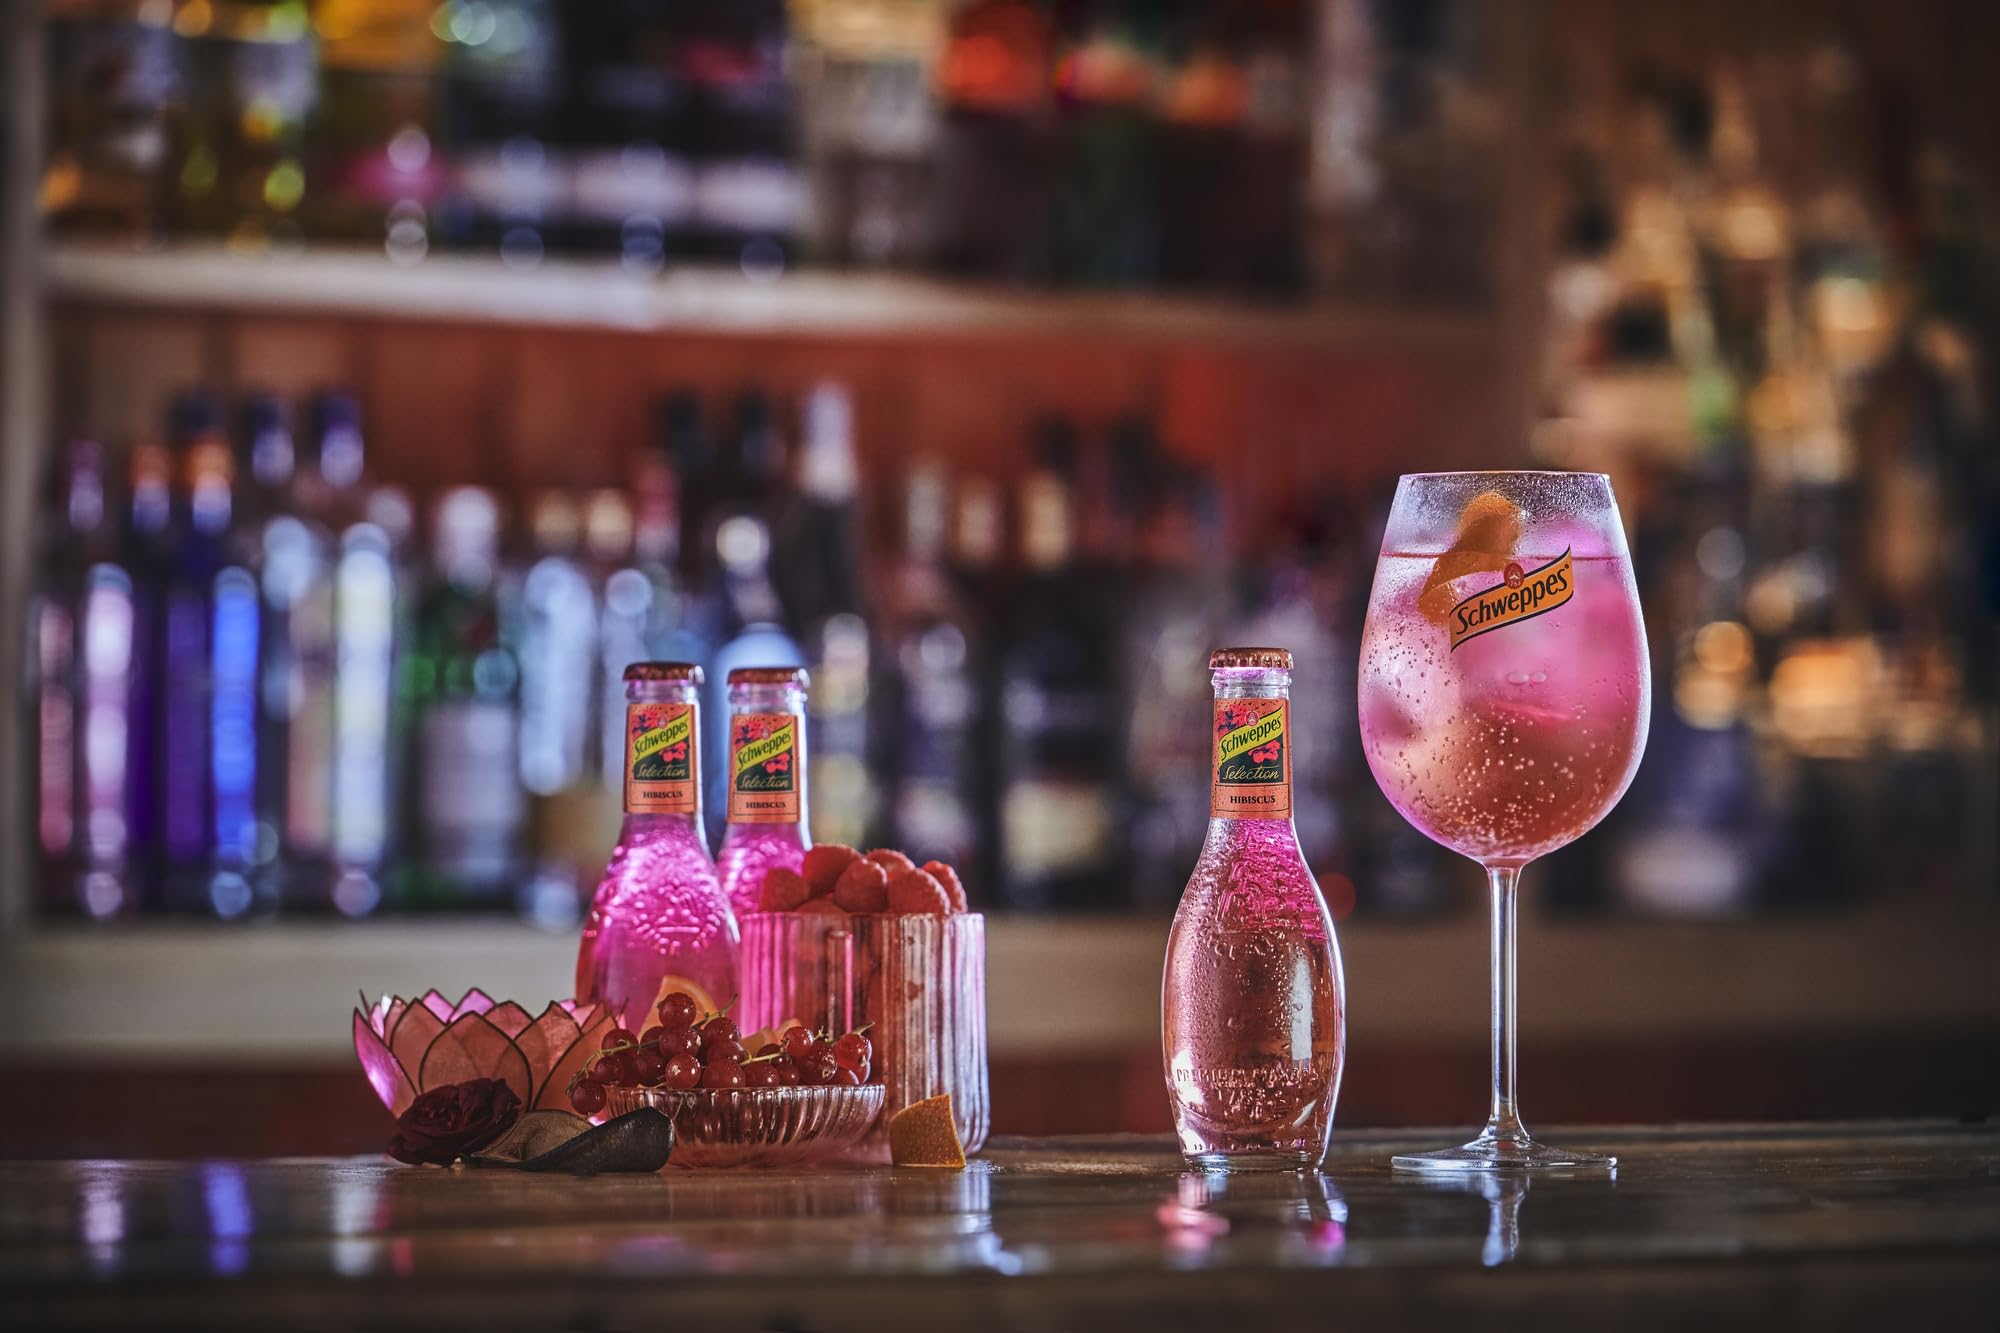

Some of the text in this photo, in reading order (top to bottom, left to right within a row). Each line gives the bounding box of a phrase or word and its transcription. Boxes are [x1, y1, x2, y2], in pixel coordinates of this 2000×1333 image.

[1456, 568, 1568, 635] Schweppes
[634, 720, 688, 760] Schweppes
[1221, 717, 1282, 760] Schweppes
[737, 732, 791, 771] Schweppes
[637, 763, 687, 778] Selection
[1223, 764, 1280, 780] Selection
[740, 774, 790, 789] Selection
[643, 791, 683, 799] HIBISCUS
[1230, 795, 1276, 804] HIBISCUS
[745, 801, 786, 809] HIBISCUS
